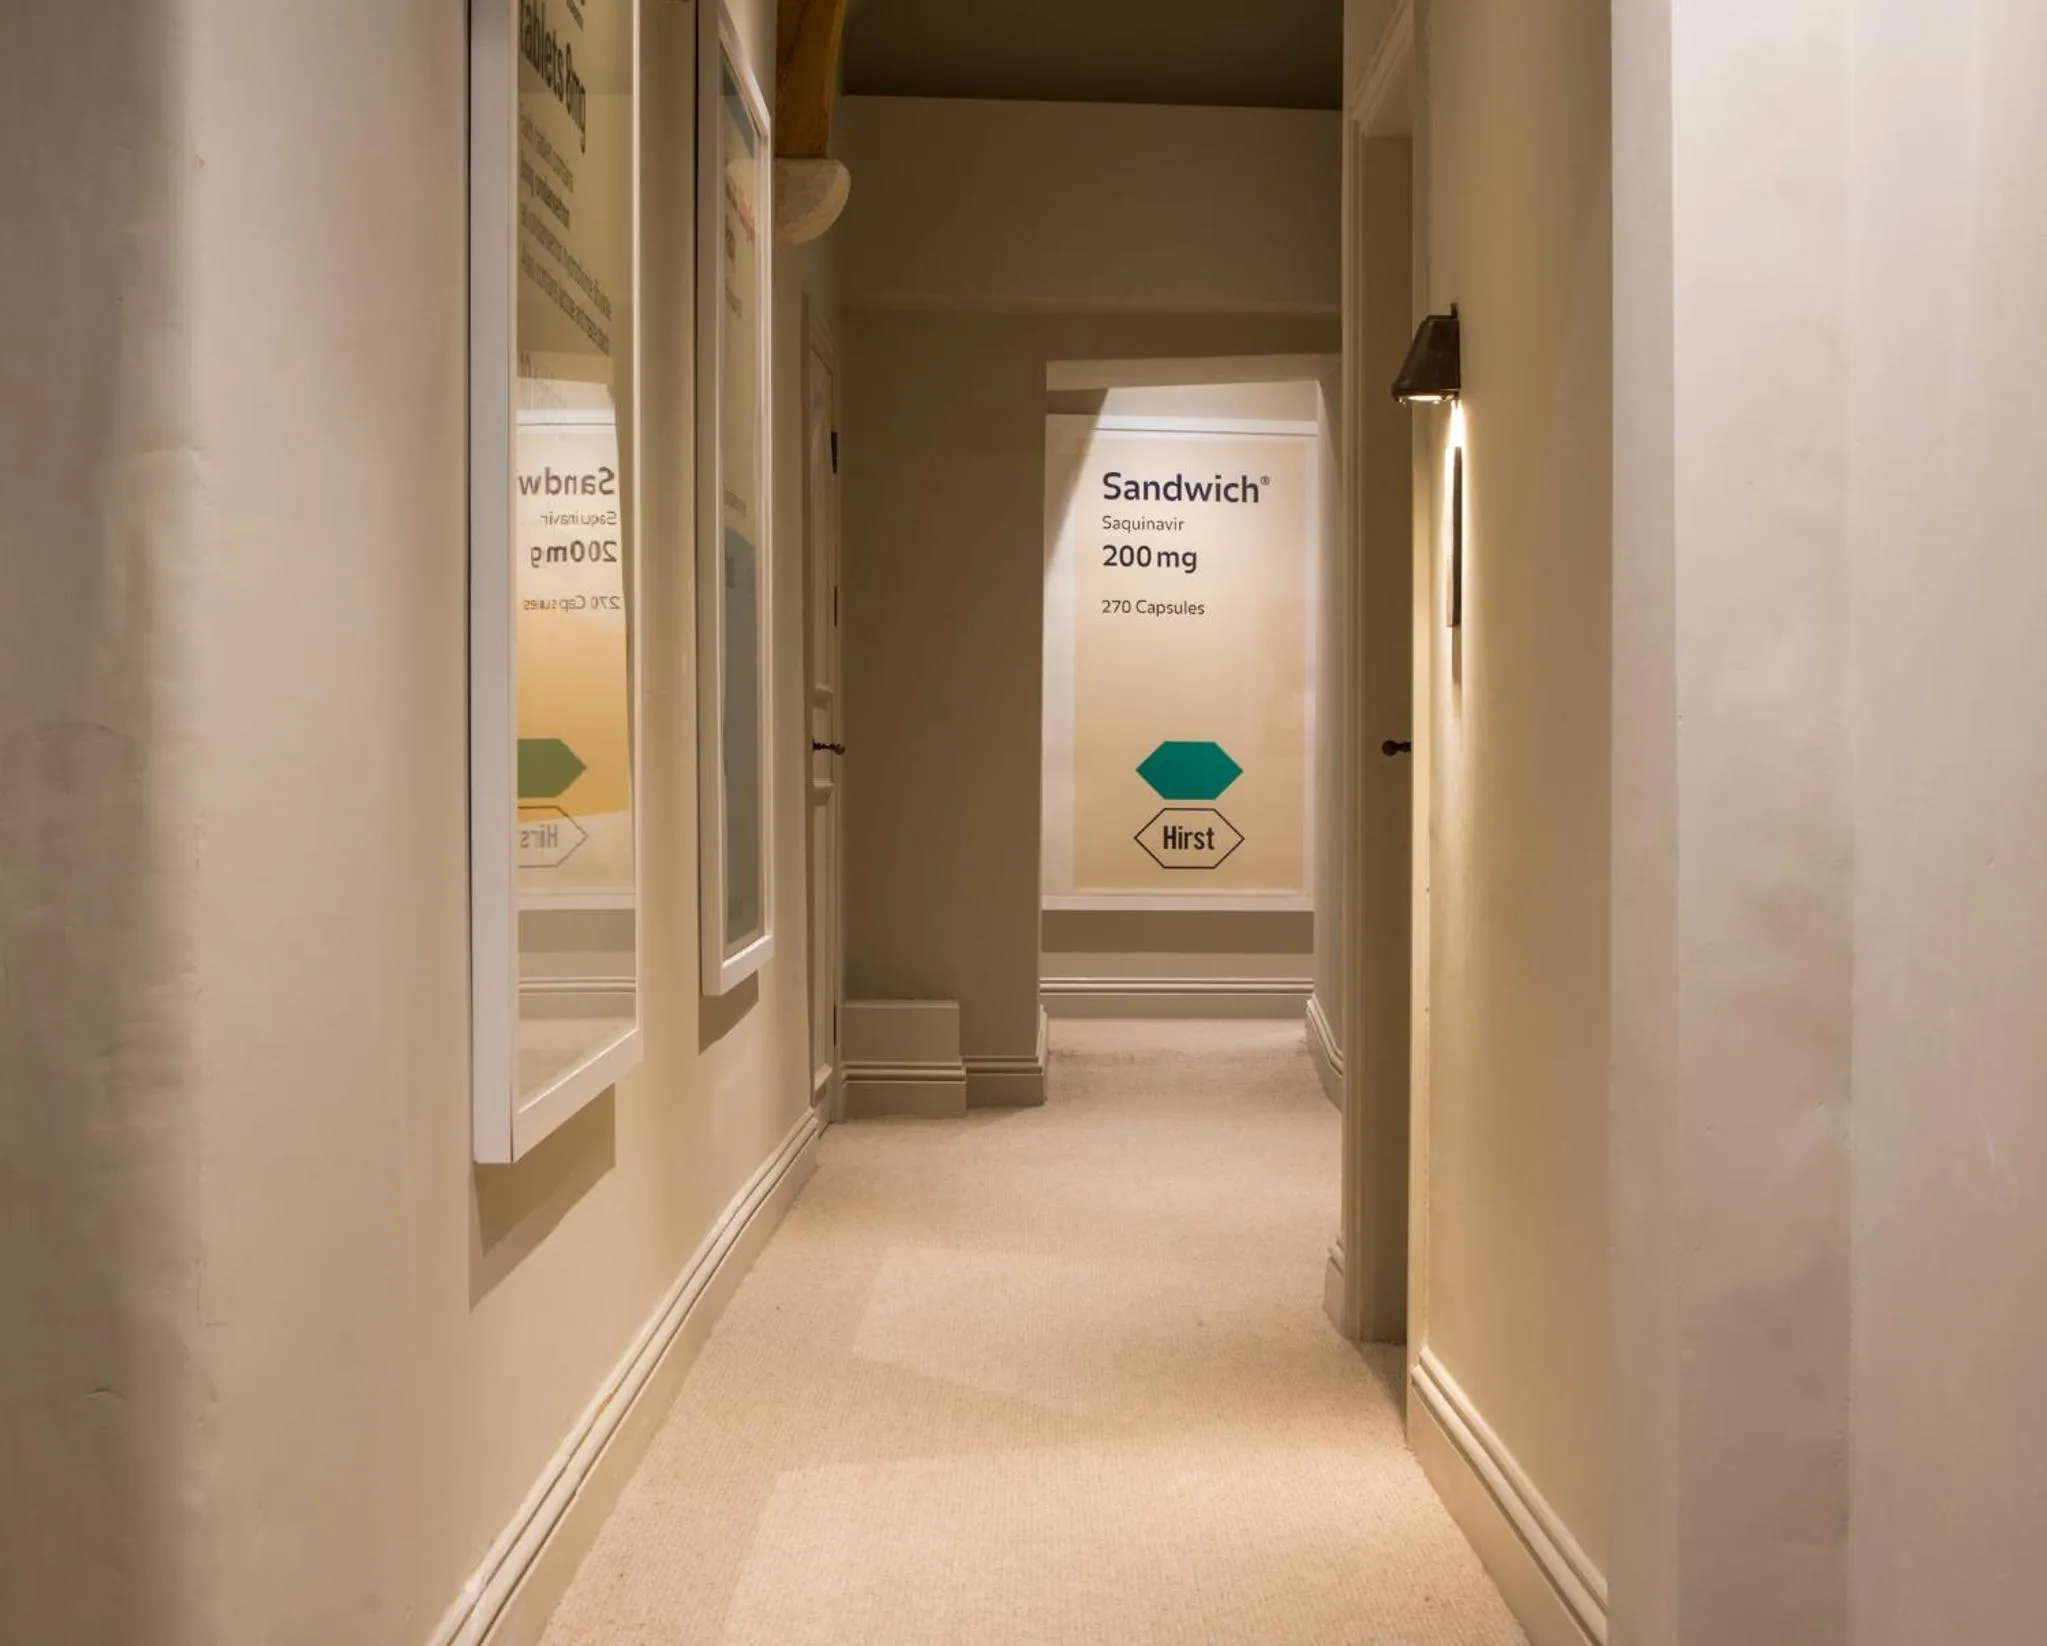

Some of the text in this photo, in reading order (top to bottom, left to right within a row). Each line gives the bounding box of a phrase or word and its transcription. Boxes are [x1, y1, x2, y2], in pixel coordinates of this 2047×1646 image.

[1102, 515, 1185, 534] Saquinavir
[1102, 599, 1205, 617] 270 Capsules
[1163, 825, 1216, 850] Hirst
